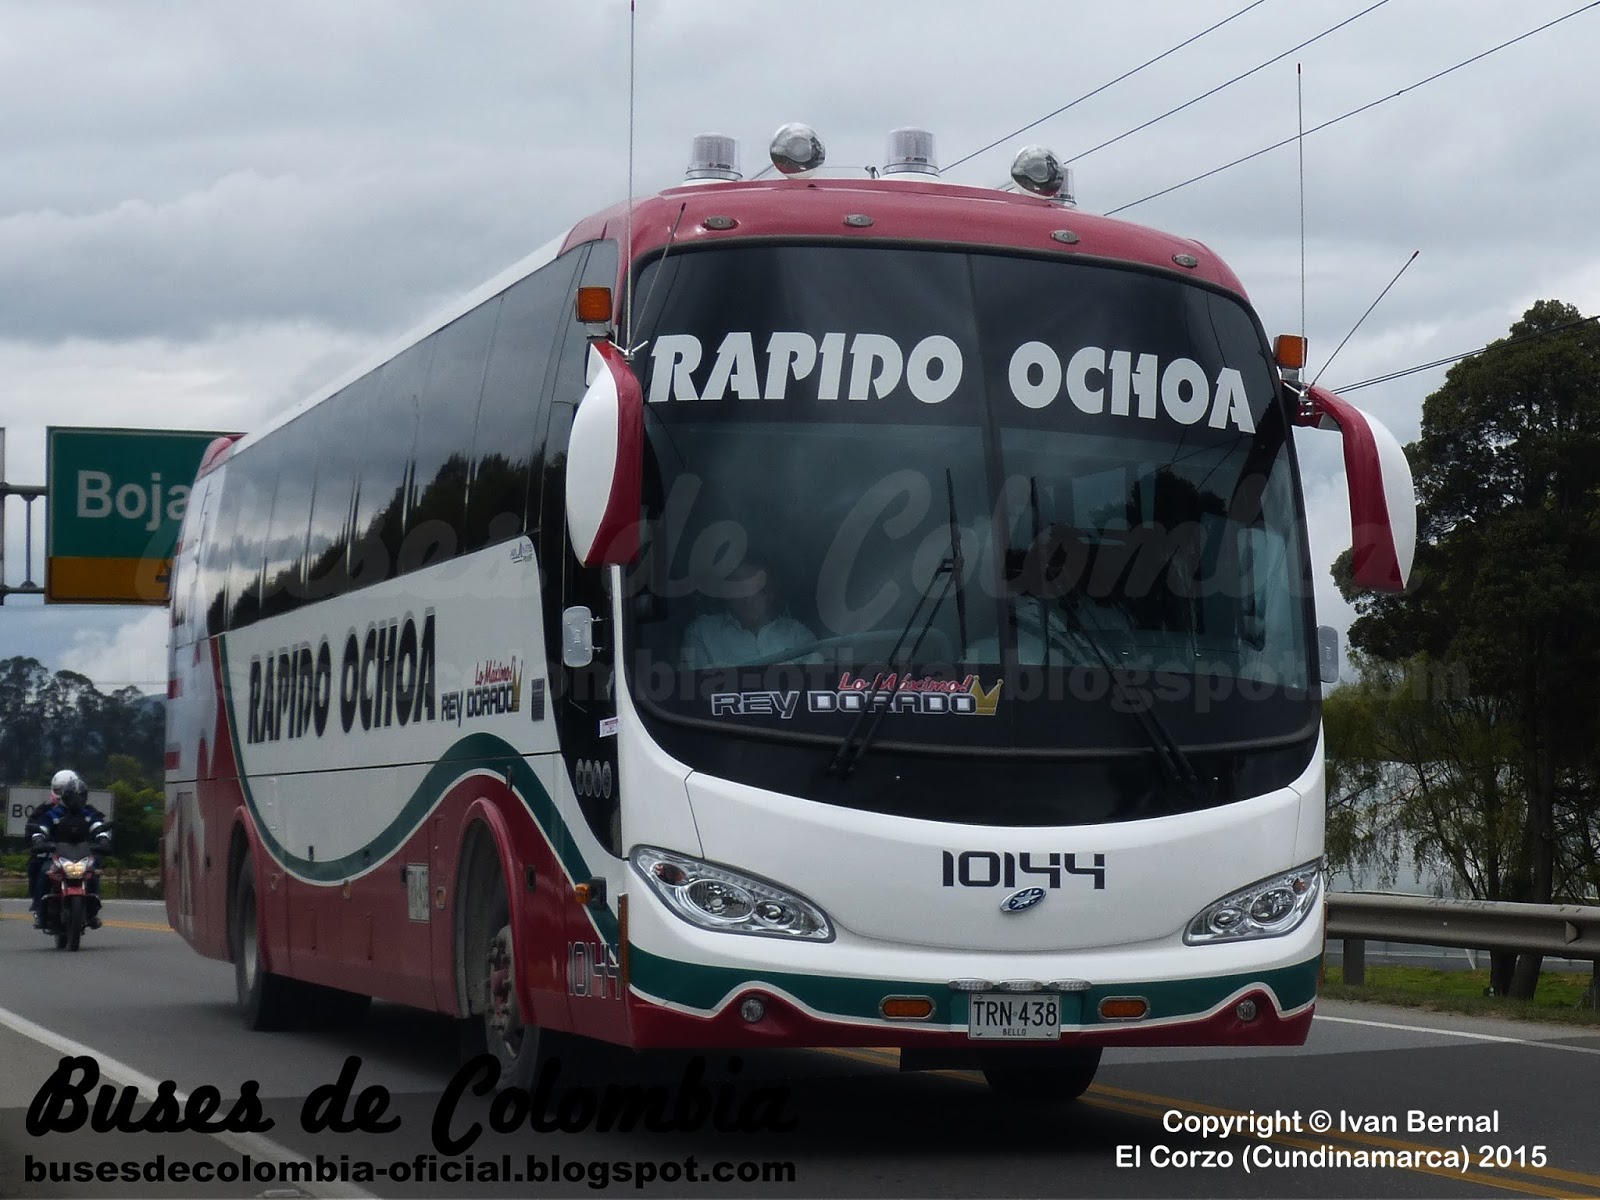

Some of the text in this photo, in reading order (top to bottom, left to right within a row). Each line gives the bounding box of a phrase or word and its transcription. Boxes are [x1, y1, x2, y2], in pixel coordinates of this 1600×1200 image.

[648, 332, 1255, 434] RAPIDO OCHOA
[76, 470, 192, 531] Boja
[247, 606, 436, 744] RAPIDO OCHOA
[838, 671, 870, 690] Lo
[441, 690, 463, 728] REY
[466, 683, 514, 718] DORADO
[711, 690, 977, 719] REY DORADO
[942, 850, 1105, 890] 10144
[567, 941, 621, 1001] 10144
[973, 1001, 1057, 1027] TRN 438
[1002, 1028, 1027, 1037] BELLO
